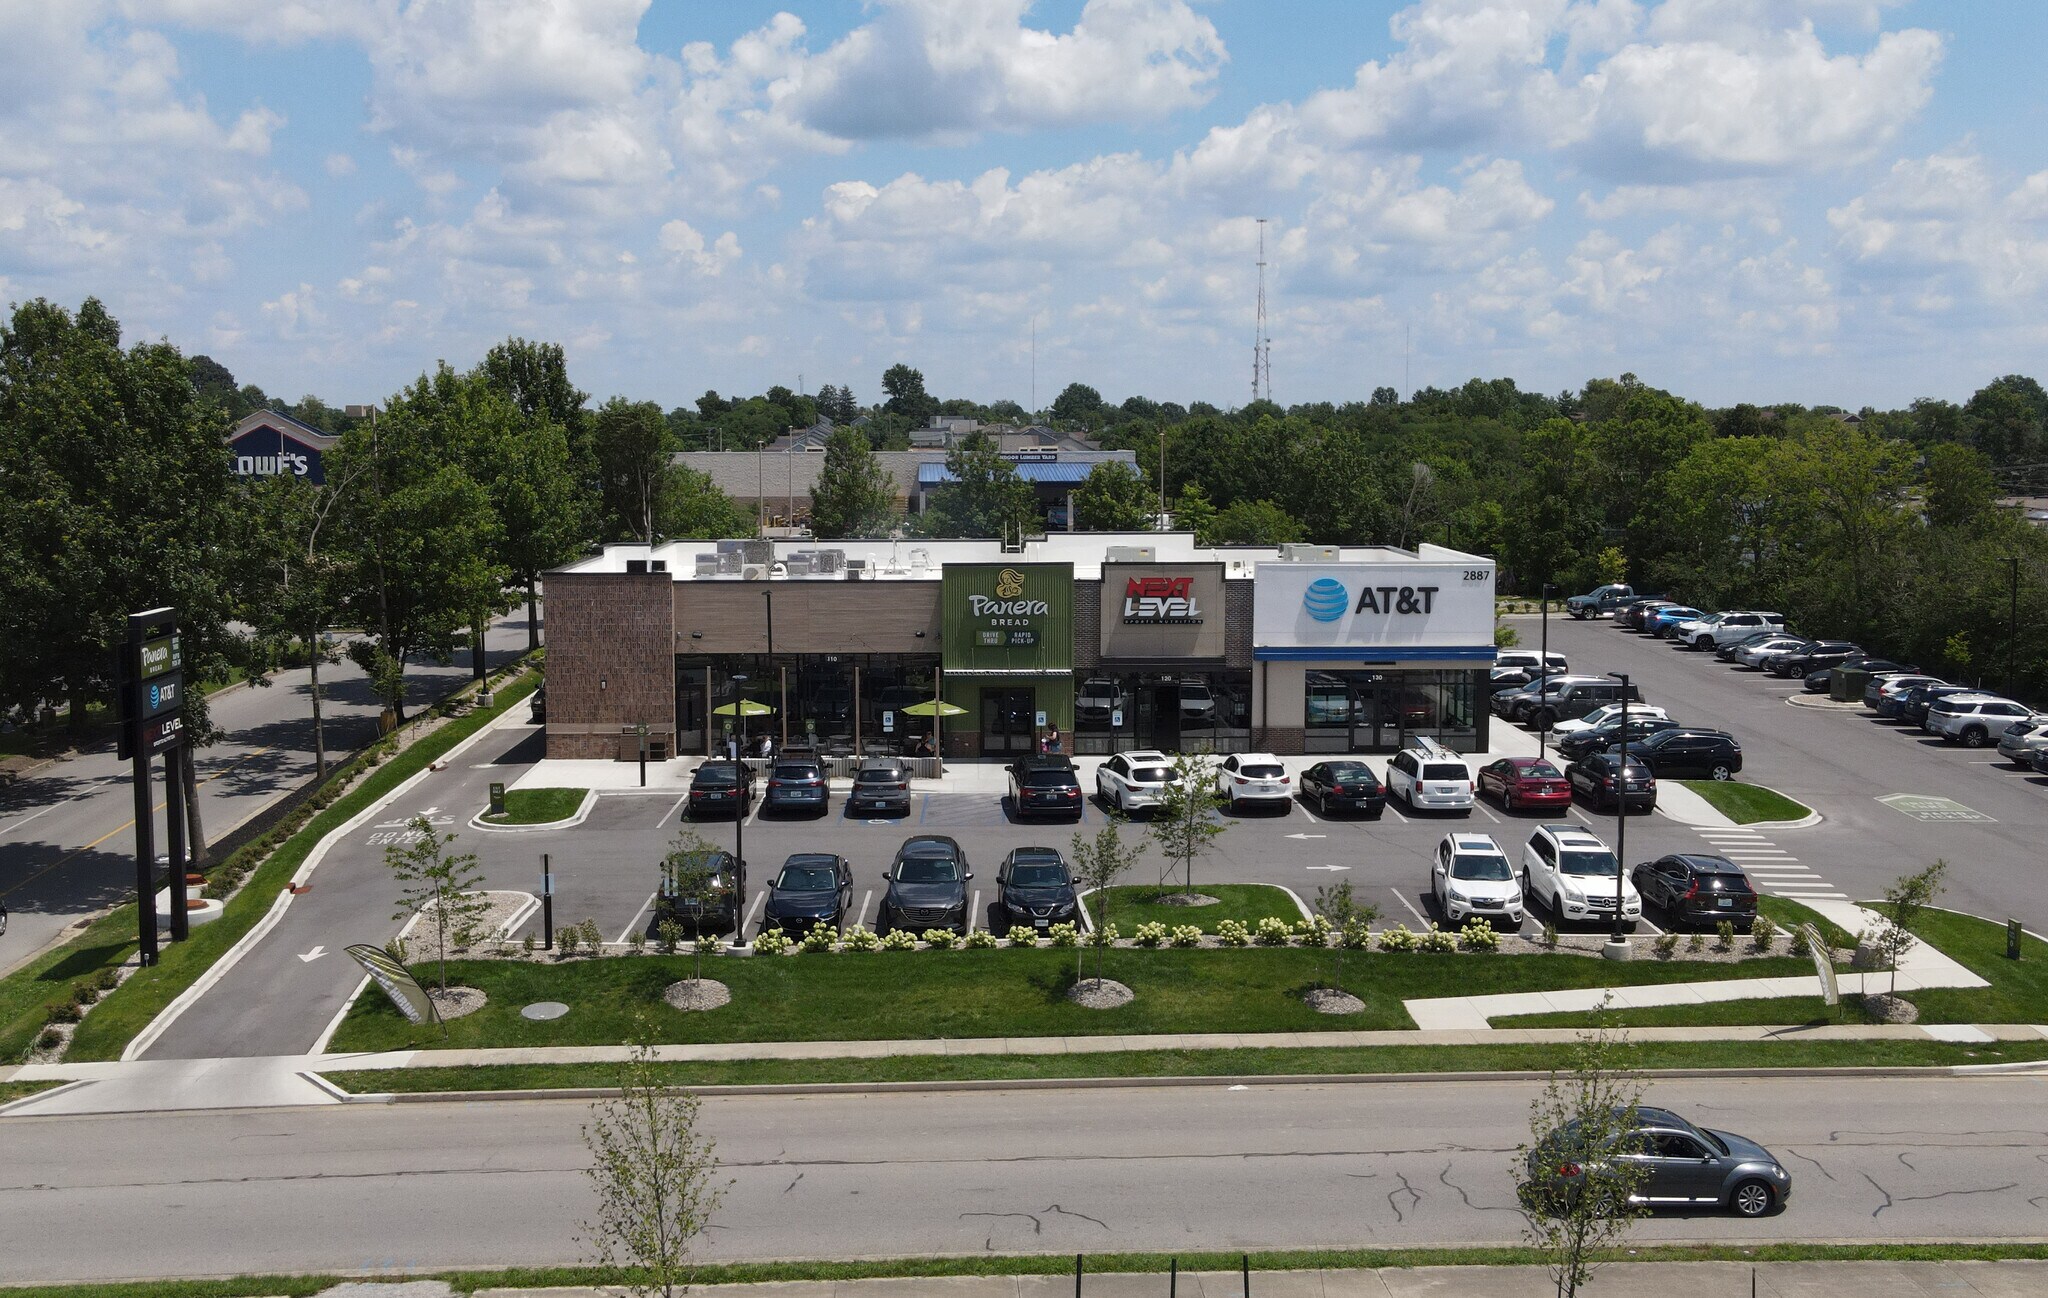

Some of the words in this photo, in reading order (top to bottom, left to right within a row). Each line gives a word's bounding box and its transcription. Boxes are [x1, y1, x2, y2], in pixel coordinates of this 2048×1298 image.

[230, 452, 308, 475] OWE'S
[1463, 570, 1490, 581] 2887
[1126, 576, 1194, 601] NEXT
[968, 594, 1048, 617] Panera
[1124, 597, 1202, 618] LEVEL
[1355, 586, 1439, 614] AT&T
[991, 618, 1029, 626] BREAD
[142, 646, 168, 666] Panera
[160, 683, 175, 702] AT&T
[161, 718, 183, 735] LEVEL
[369, 831, 398, 840] DO
[389, 986, 422, 1025] HIRING!
